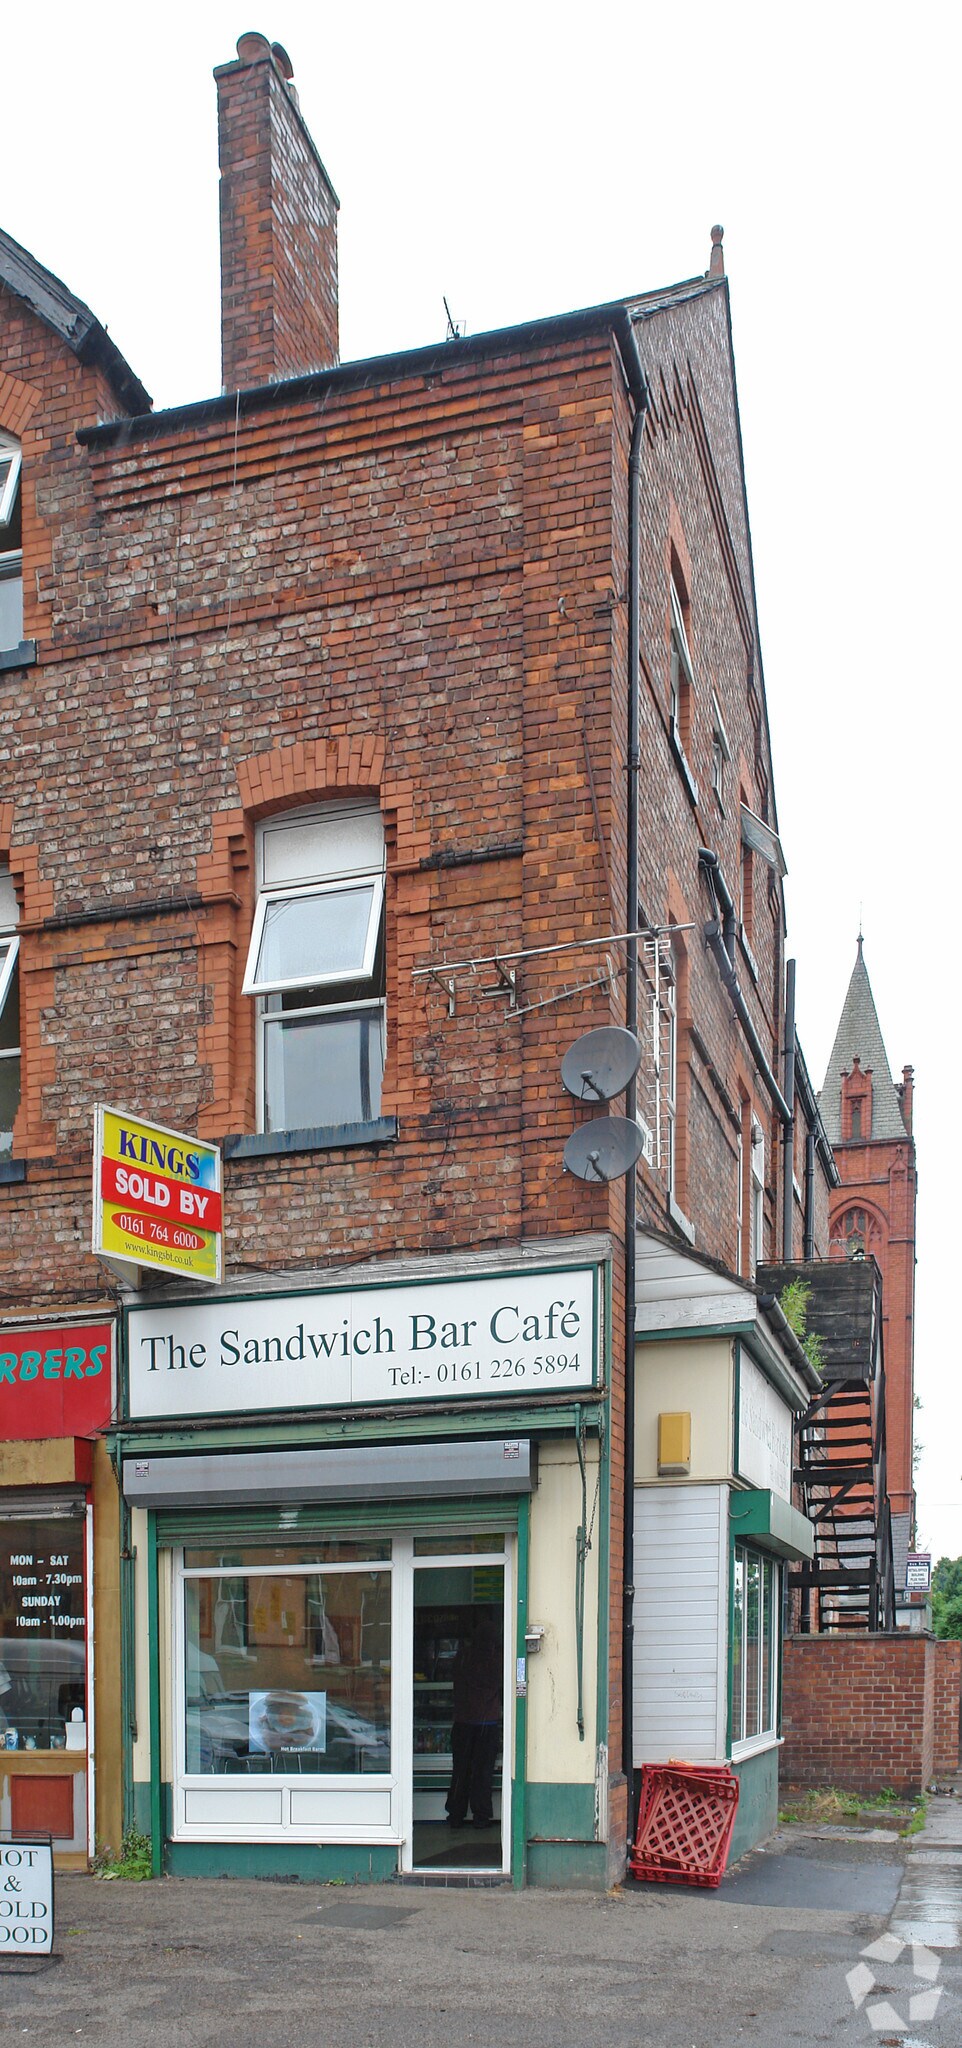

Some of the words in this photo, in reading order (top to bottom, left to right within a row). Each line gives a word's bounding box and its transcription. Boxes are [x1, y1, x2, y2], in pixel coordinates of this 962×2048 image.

[118, 1128, 200, 1180] KINGS
[115, 1167, 171, 1208] SOLD
[179, 1189, 209, 1219] BY
[119, 1214, 145, 1235] 0161
[150, 1223, 169, 1242] 764
[173, 1231, 198, 1249] 6000
[124, 1241, 194, 1267] www.kingsbt.co.uk
[140, 1334, 207, 1372] The
[220, 1316, 396, 1367] Sandwich
[408, 1313, 477, 1351] Bar
[489, 1299, 580, 1344] Café
[388, 1365, 431, 1386] Tel:-
[437, 1361, 481, 1383] 0161
[490, 1357, 526, 1379] 226
[533, 1353, 580, 1375] 5894
[10, 1555, 33, 1566] MON
[49, 1555, 69, 1566] SAT
[45, 1573, 82, 1586] 7.30pm
[21, 1596, 61, 1607] SUNDAY
[0, 1849, 38, 1867] OT
[3, 1875, 22, 1892] &
